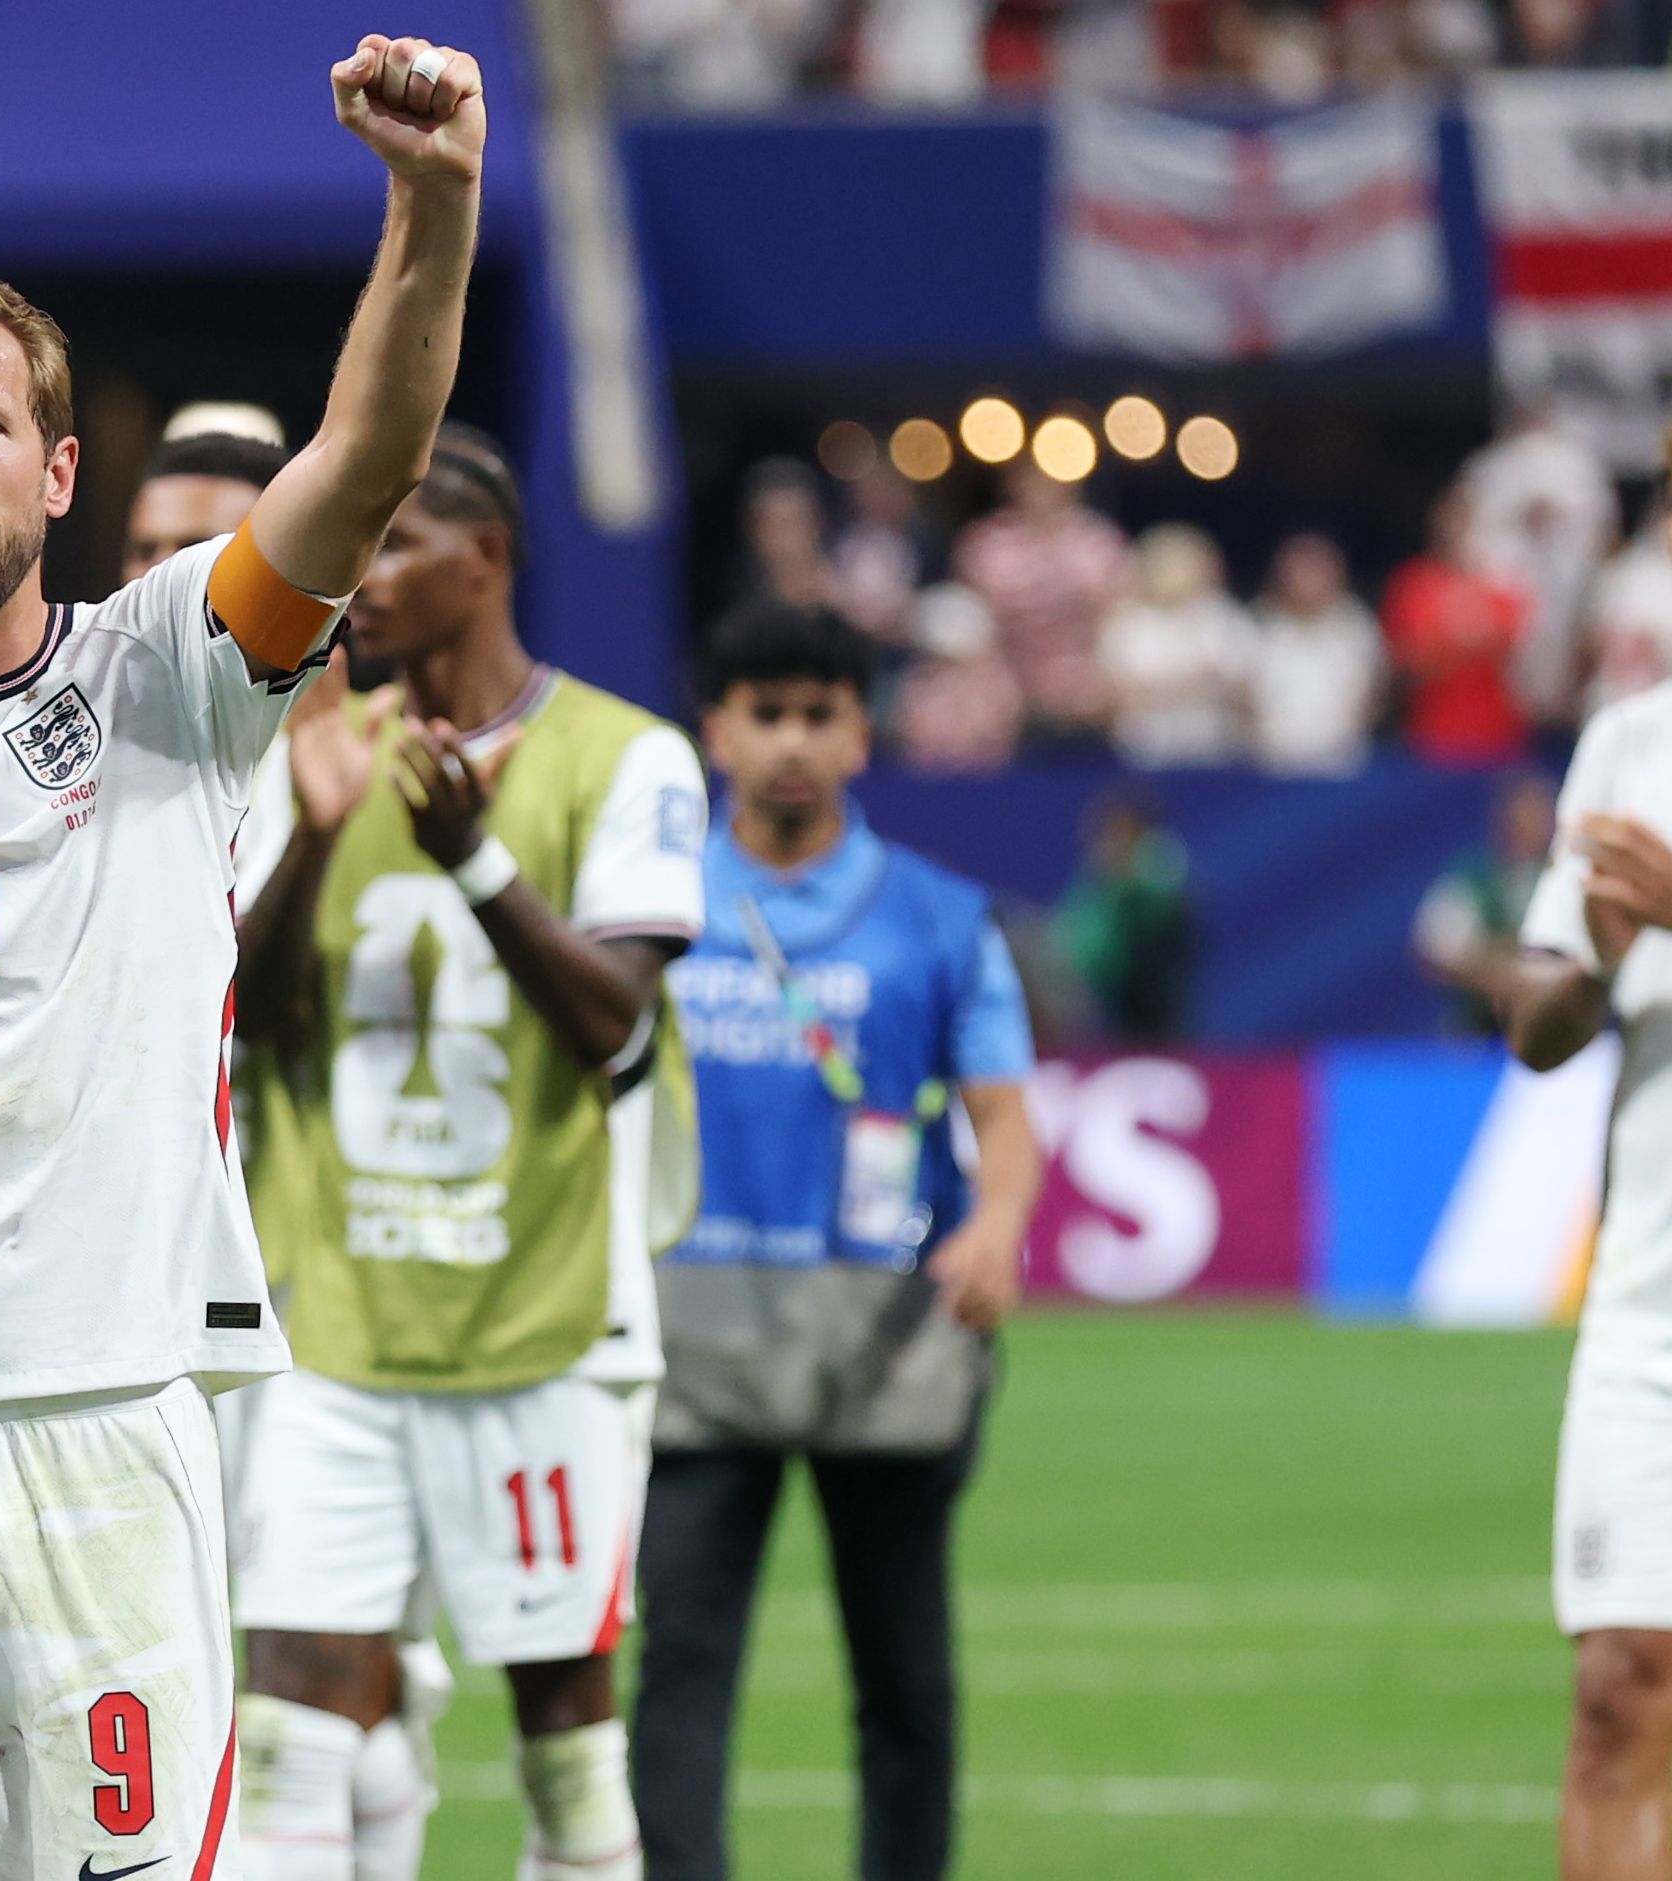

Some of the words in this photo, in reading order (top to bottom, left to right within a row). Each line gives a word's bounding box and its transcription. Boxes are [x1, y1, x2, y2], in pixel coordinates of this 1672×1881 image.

[51, 781, 96, 810] CONGO
[506, 1465, 577, 1571] 11
[88, 1691, 155, 1836] 9
